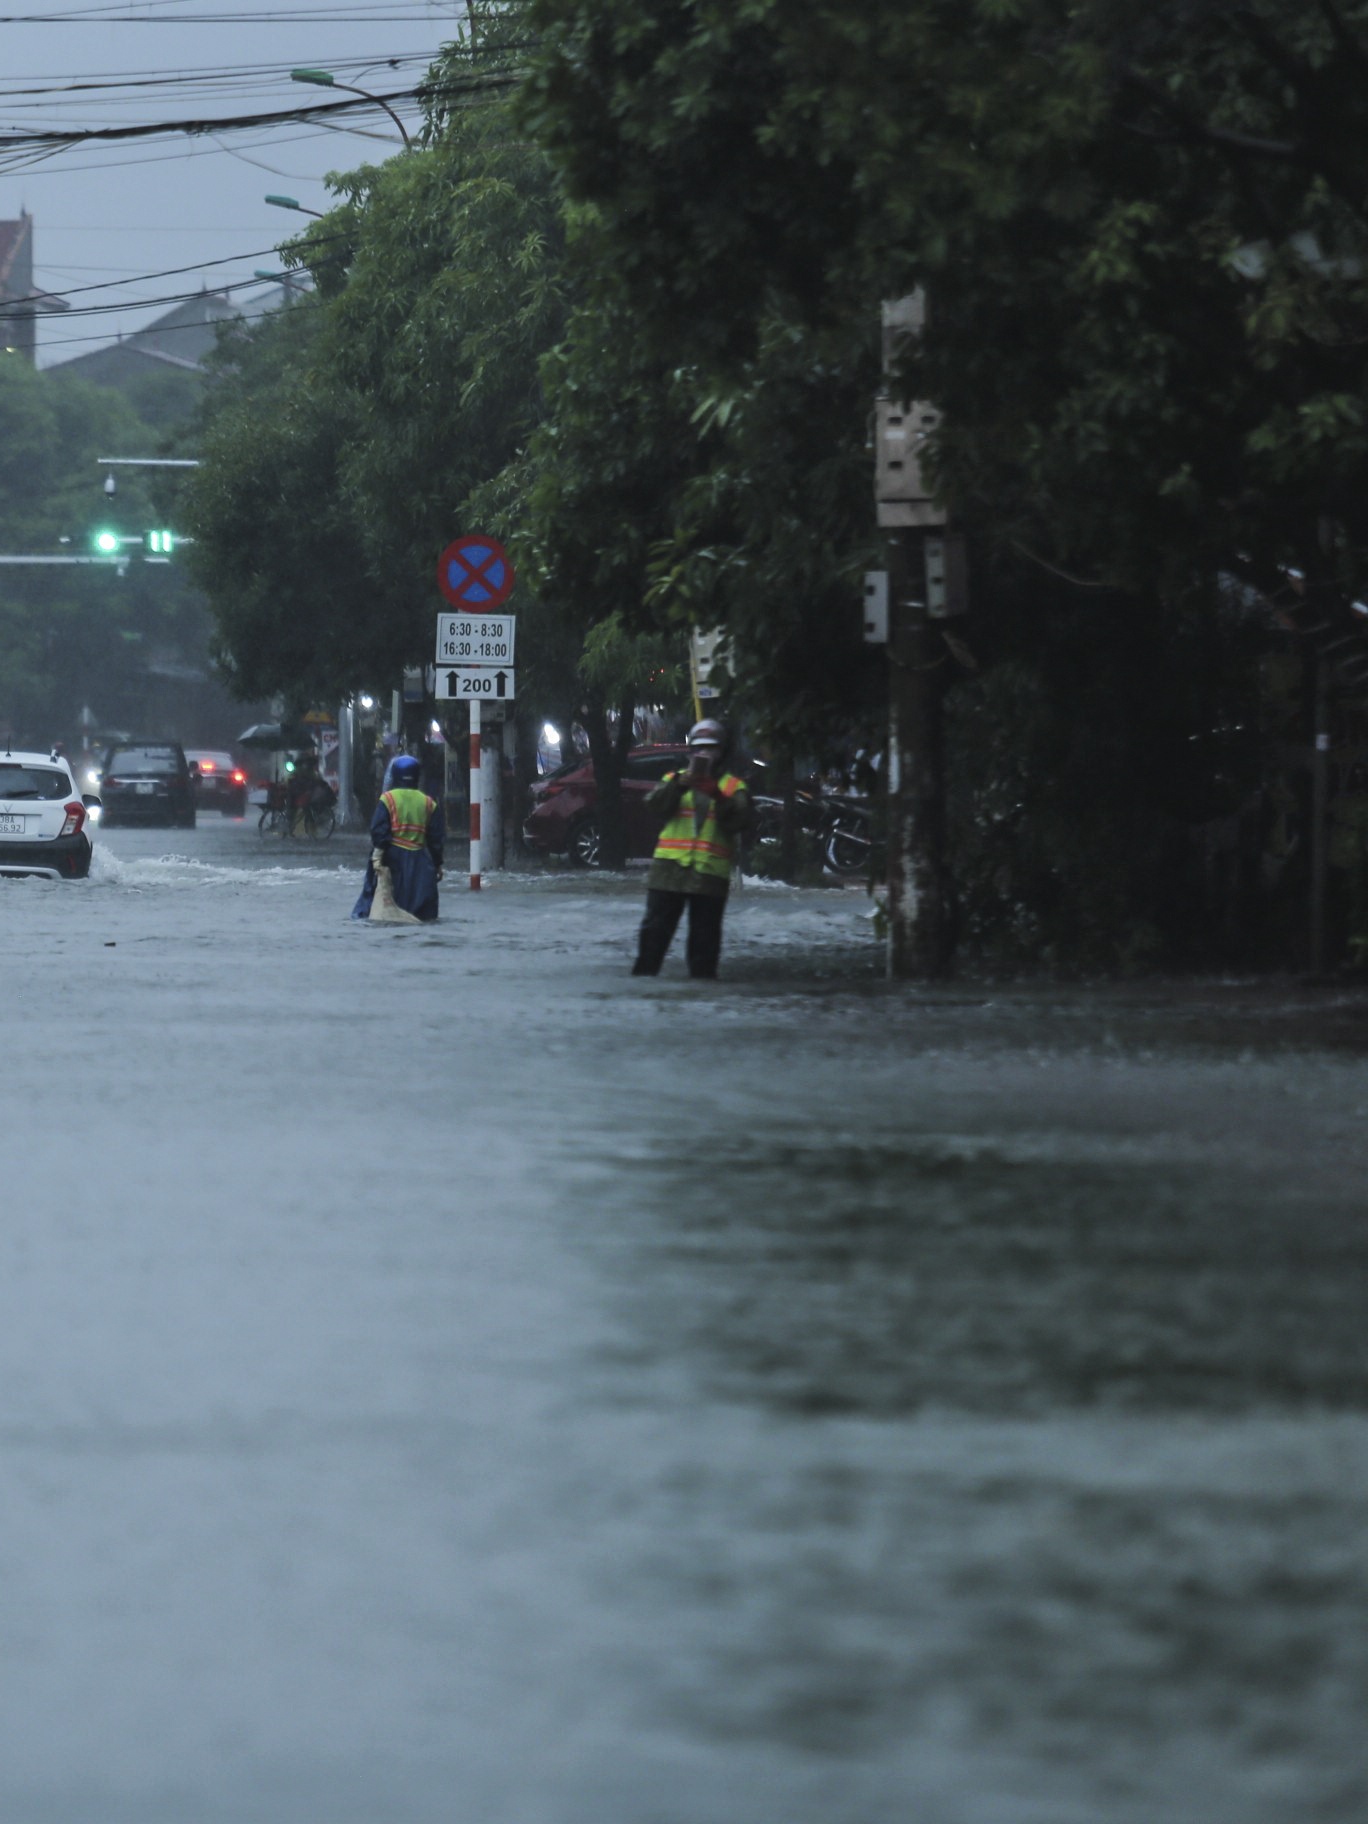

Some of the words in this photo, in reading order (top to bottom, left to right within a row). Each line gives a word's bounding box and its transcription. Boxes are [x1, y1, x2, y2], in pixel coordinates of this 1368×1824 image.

[449, 622, 472, 636] 6:30
[480, 623, 503, 637] 8:30
[443, 641, 471, 656] 16:30
[479, 643, 507, 657] 18:00
[462, 678, 492, 693] 200
[0, 815, 15, 823] 38A
